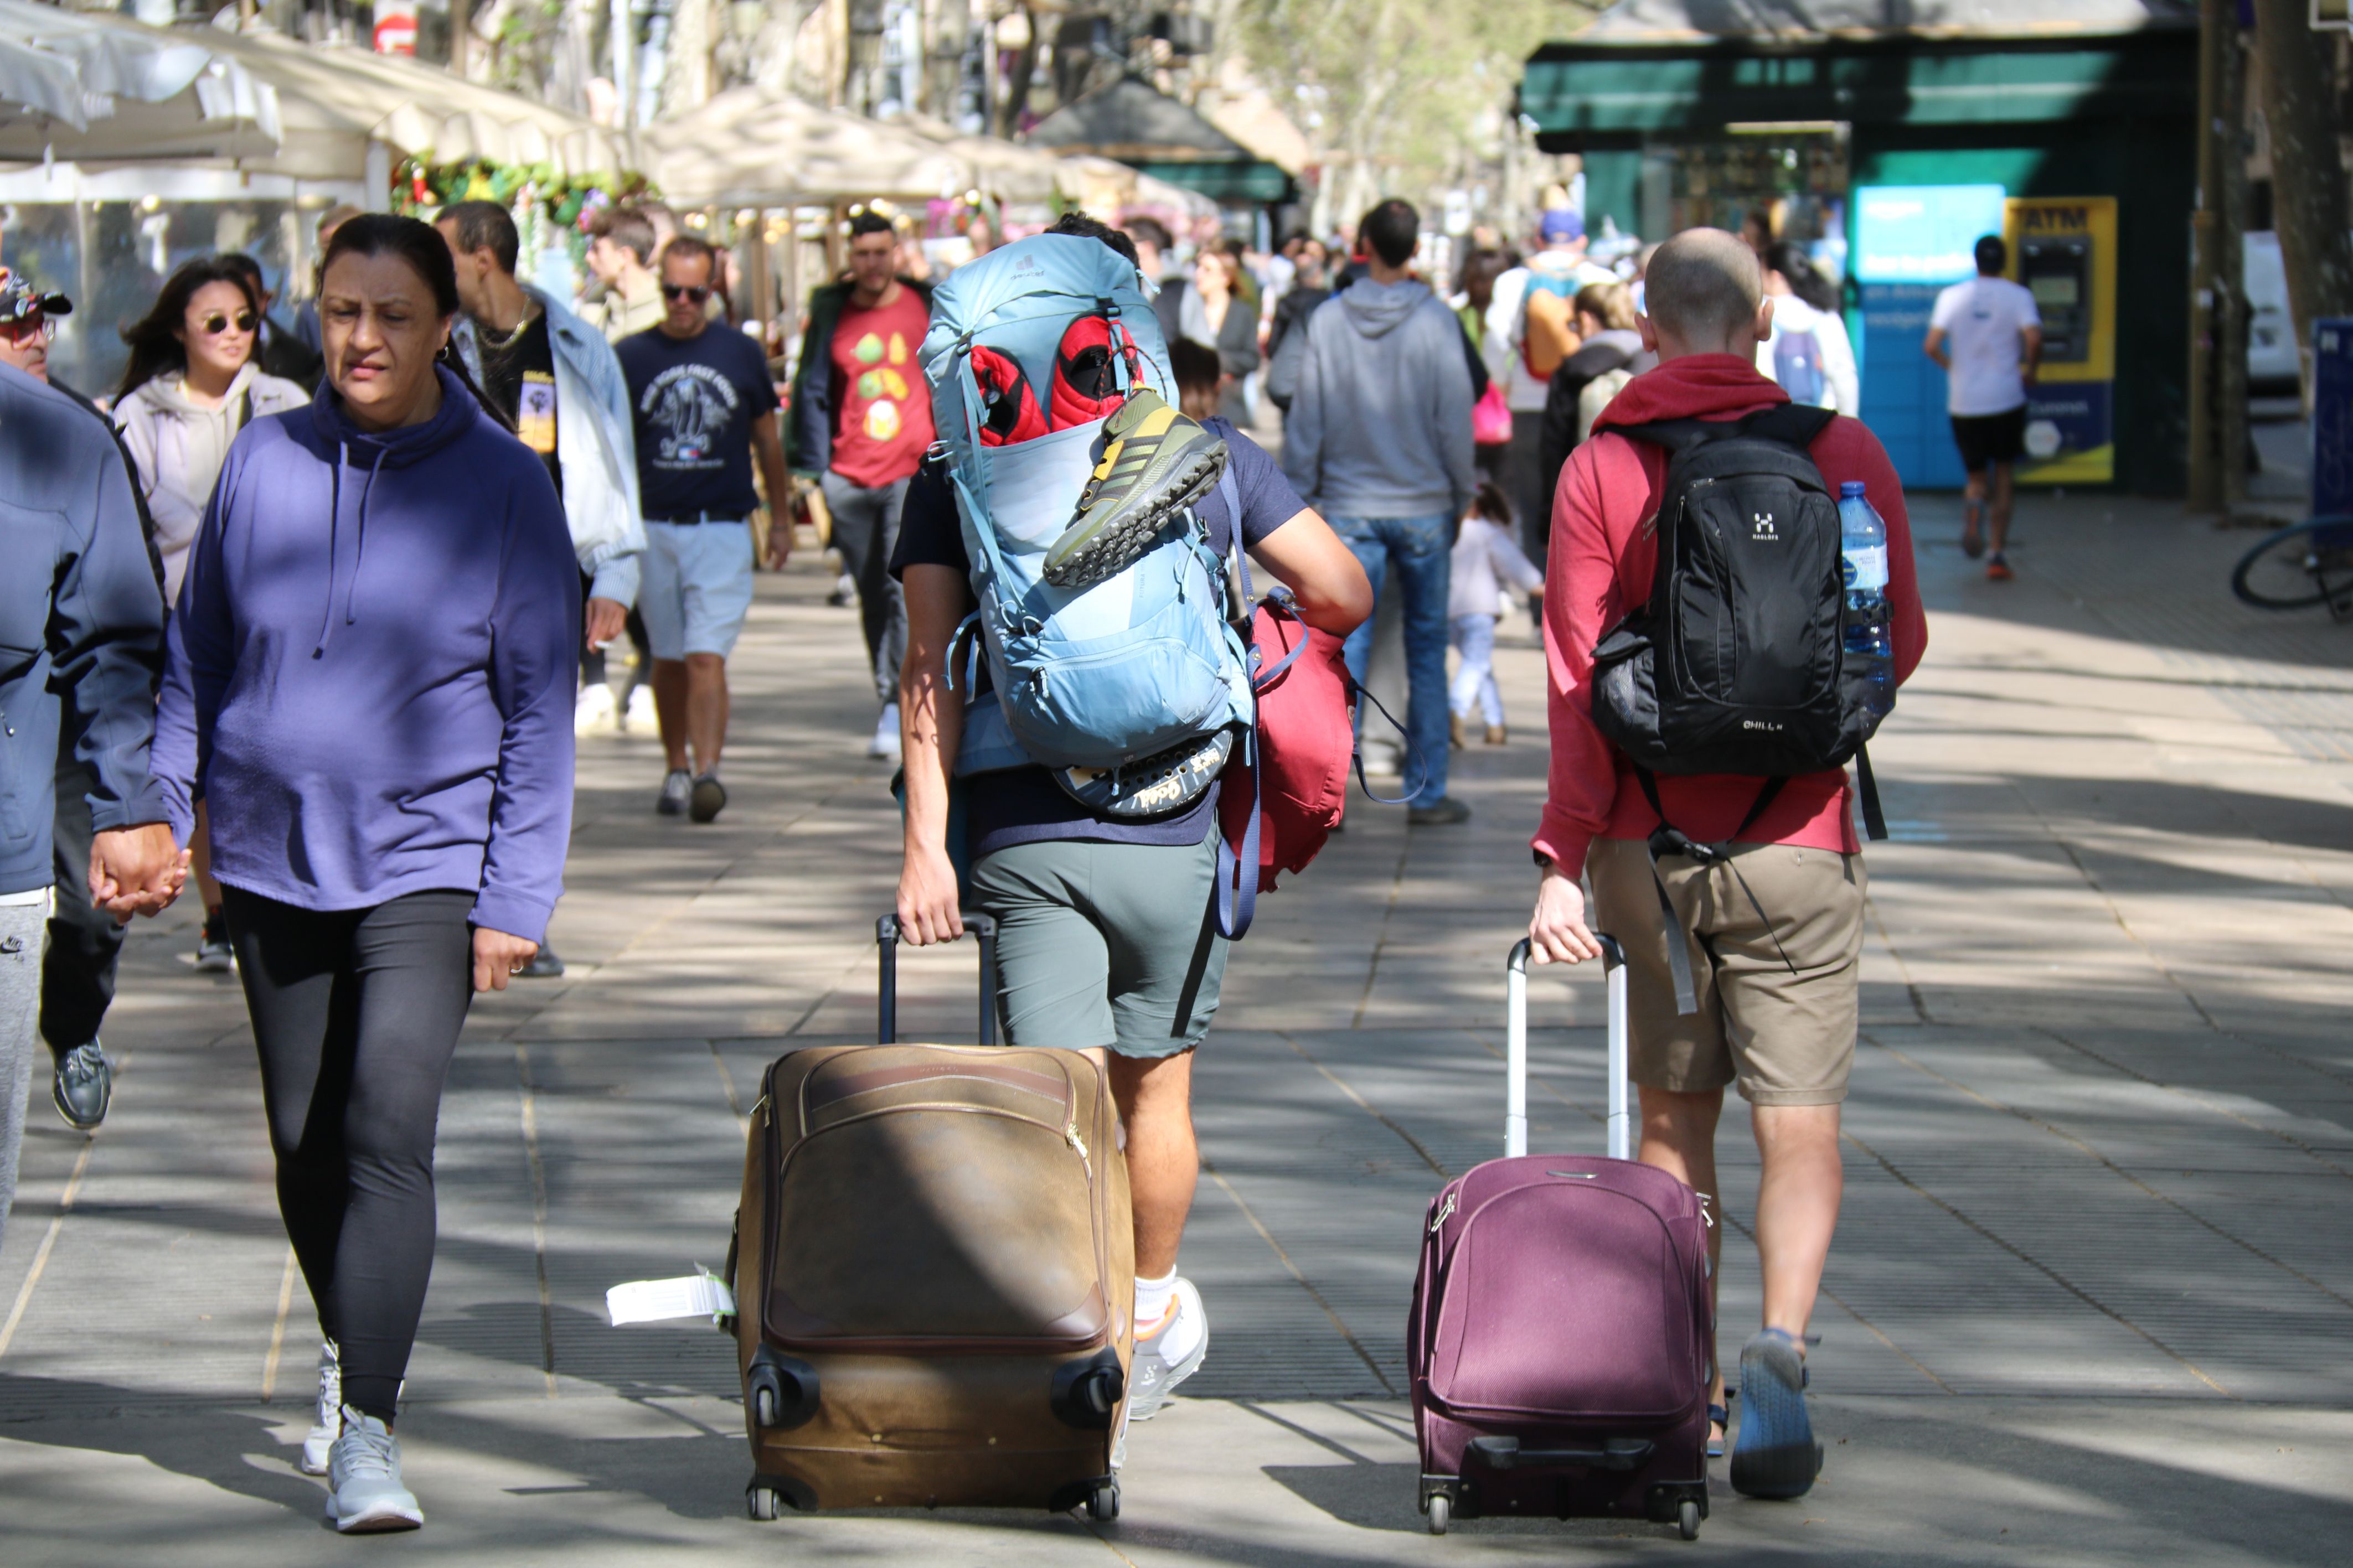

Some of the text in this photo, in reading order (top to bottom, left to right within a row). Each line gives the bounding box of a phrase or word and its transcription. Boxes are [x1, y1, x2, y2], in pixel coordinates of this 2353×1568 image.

[2025, 206, 2088, 229] ATM
[687, 363, 717, 382] FAST
[712, 373, 739, 409] FOOD
[1743, 720, 1774, 731] CHILL
[4, 935, 23, 948] NIKE
